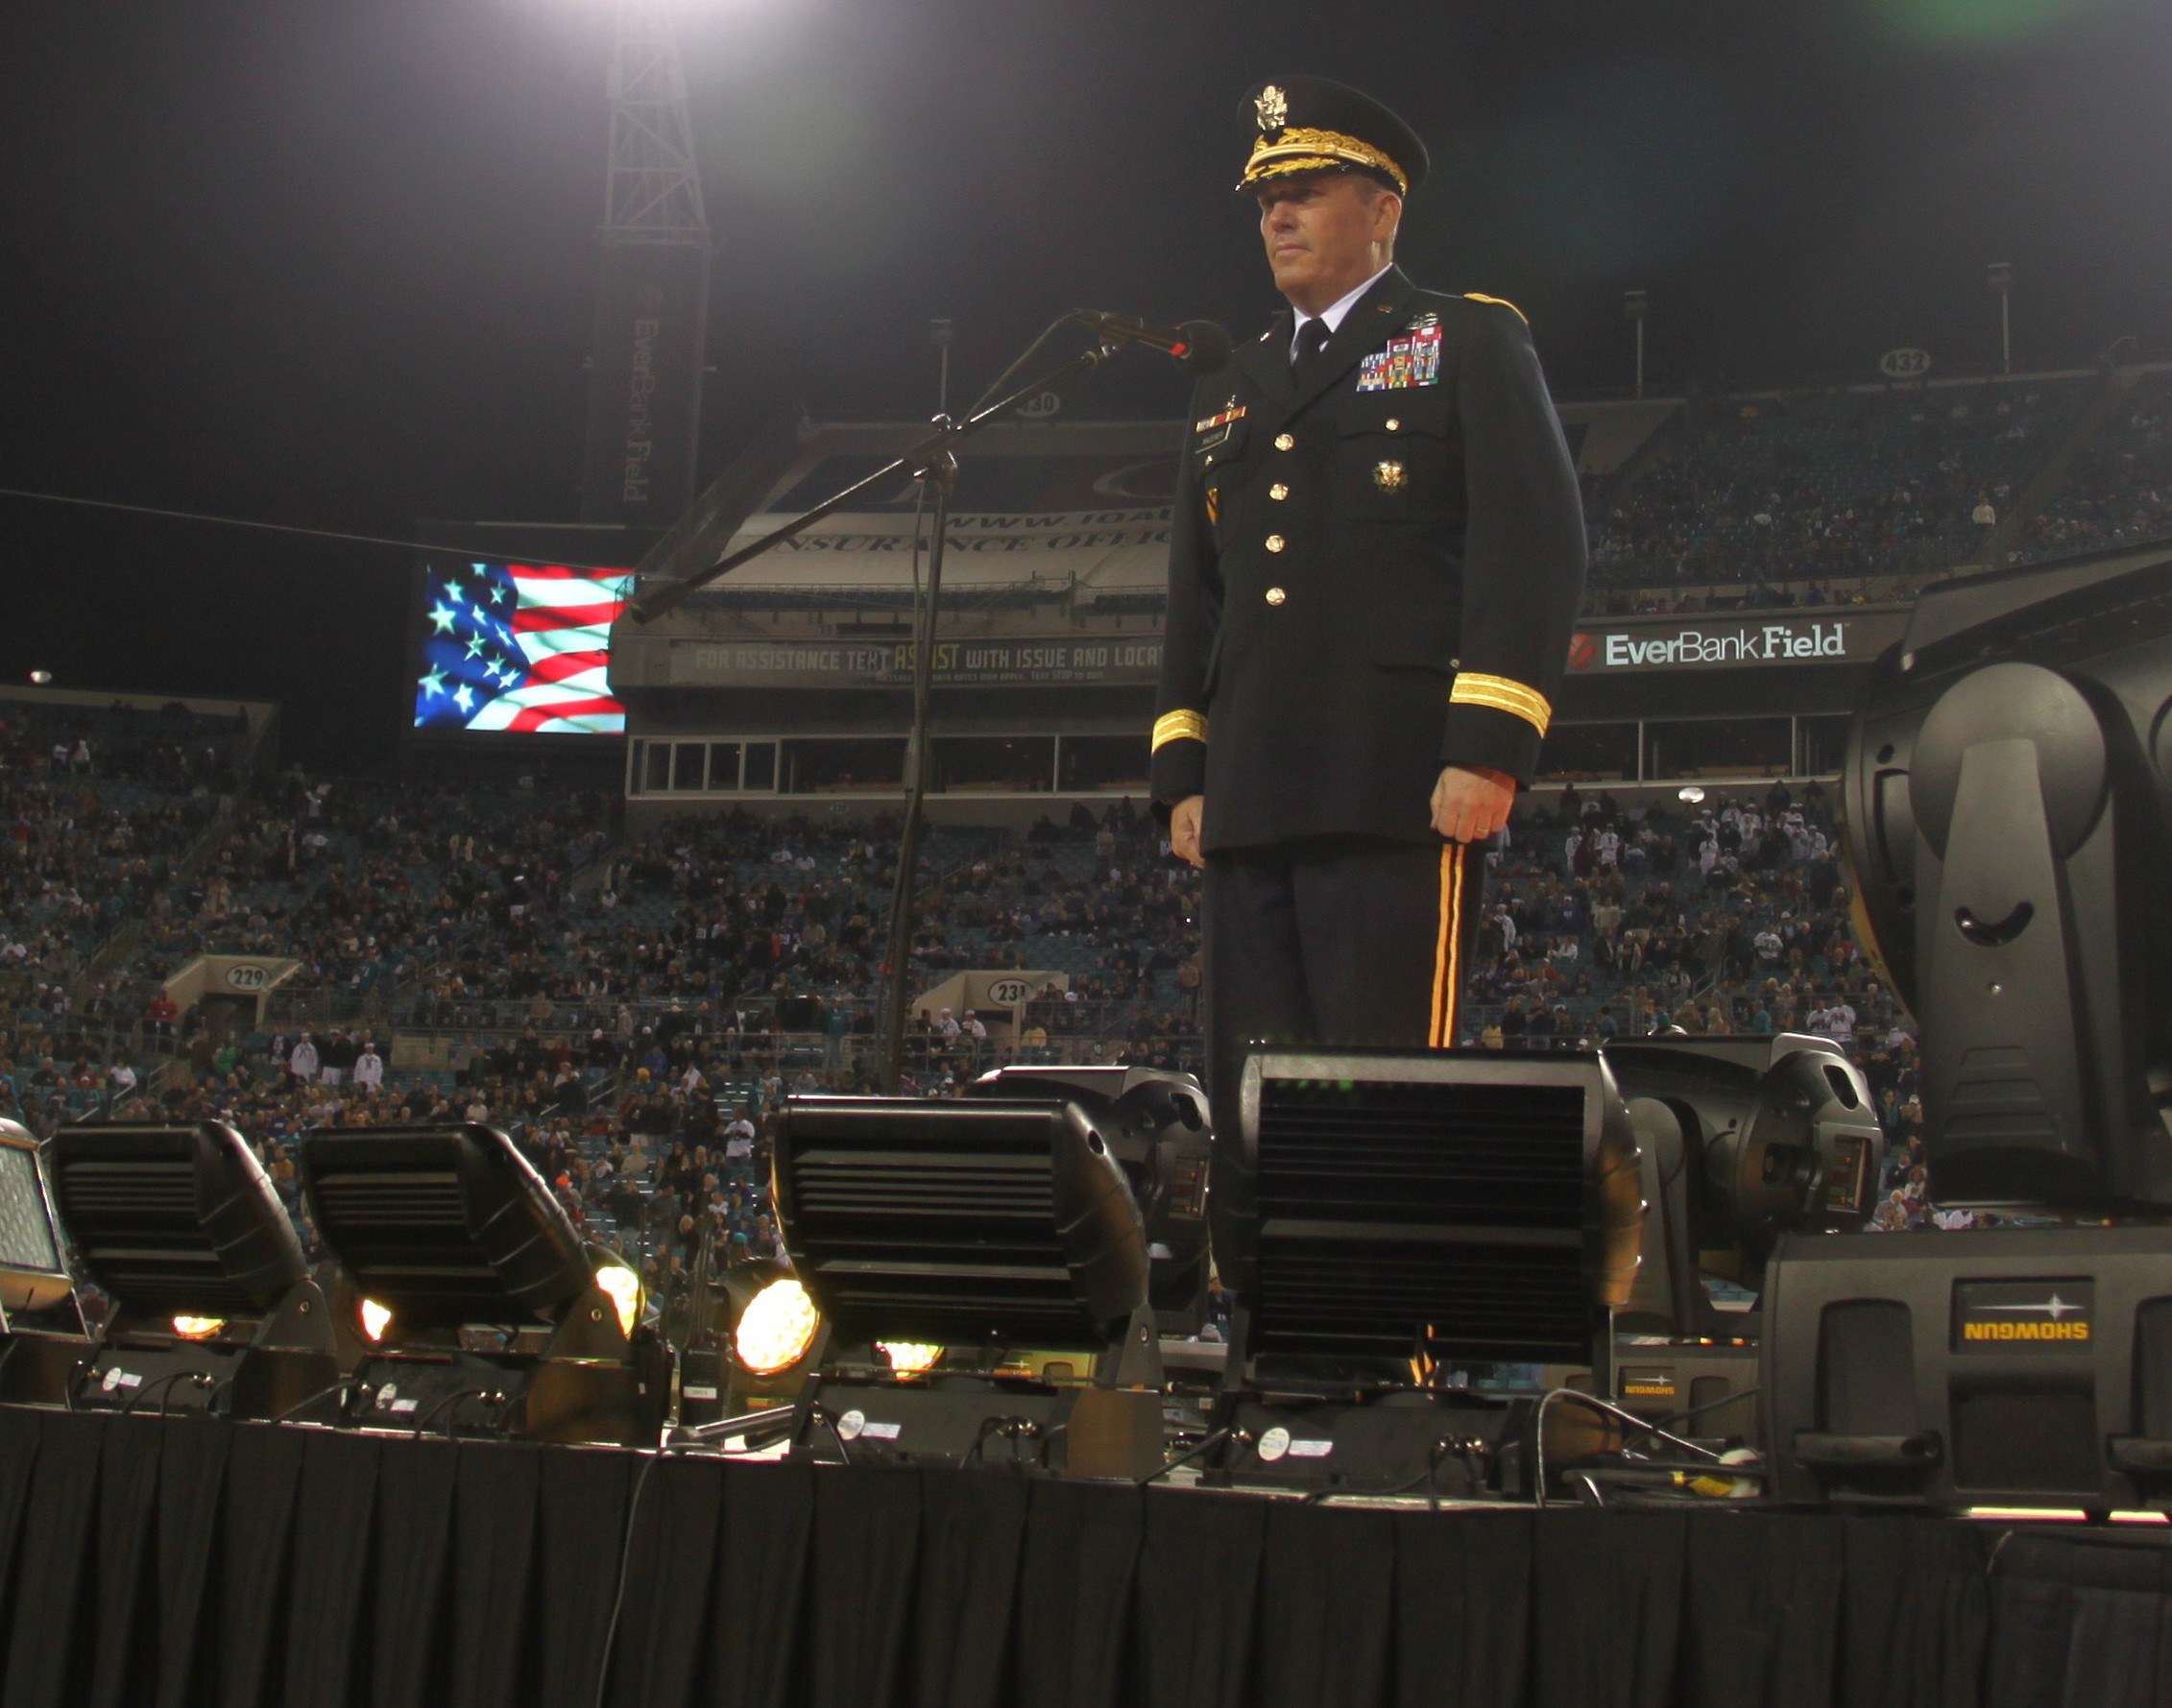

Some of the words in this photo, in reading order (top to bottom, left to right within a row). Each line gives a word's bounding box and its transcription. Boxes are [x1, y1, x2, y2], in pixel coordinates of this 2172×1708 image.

[1885, 351, 1925, 373] 432
[1605, 628, 1760, 666] EverBank
[1761, 623, 1846, 660] Field
[695, 650, 729, 668] FOR
[736, 650, 840, 671] ASSISTANCE
[894, 643, 960, 671] ASIST
[965, 648, 1010, 669] WITH
[1015, 647, 1067, 669] ISSUE
[1073, 646, 1108, 668] AND
[234, 970, 263, 985] 229
[1964, 1321, 2091, 1341] SHOWGUN
[1624, 1384, 1676, 1396] SHOWGUN
